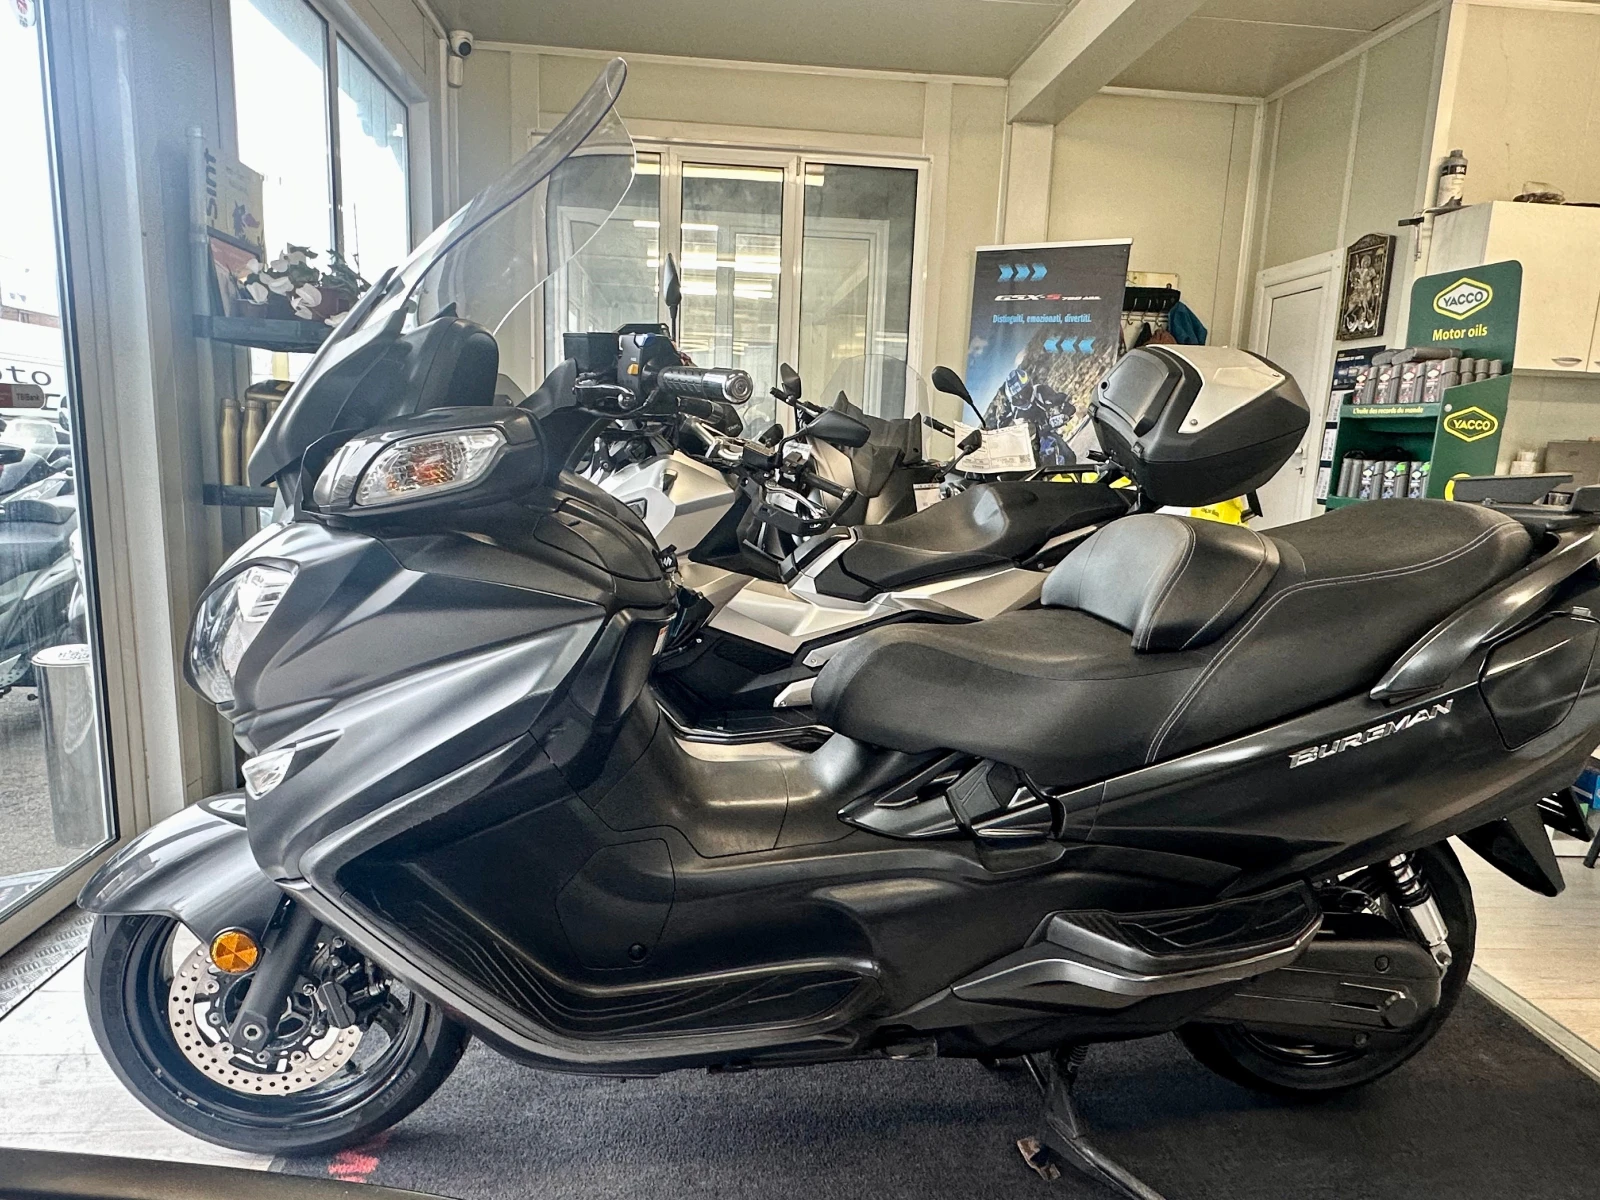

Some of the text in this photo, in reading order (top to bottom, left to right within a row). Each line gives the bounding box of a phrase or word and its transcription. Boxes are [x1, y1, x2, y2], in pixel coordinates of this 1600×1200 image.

[1442, 291, 1484, 308] YACCO
[992, 313, 1092, 324] Distinguiti, emozionati, divertiti.
[1432, 324, 1488, 341] Motor oils
[1377, 406, 1397, 414] records
[1404, 405, 1424, 414] monde
[1452, 419, 1491, 431] YACCO
[1288, 699, 1454, 769] BURGMAN
